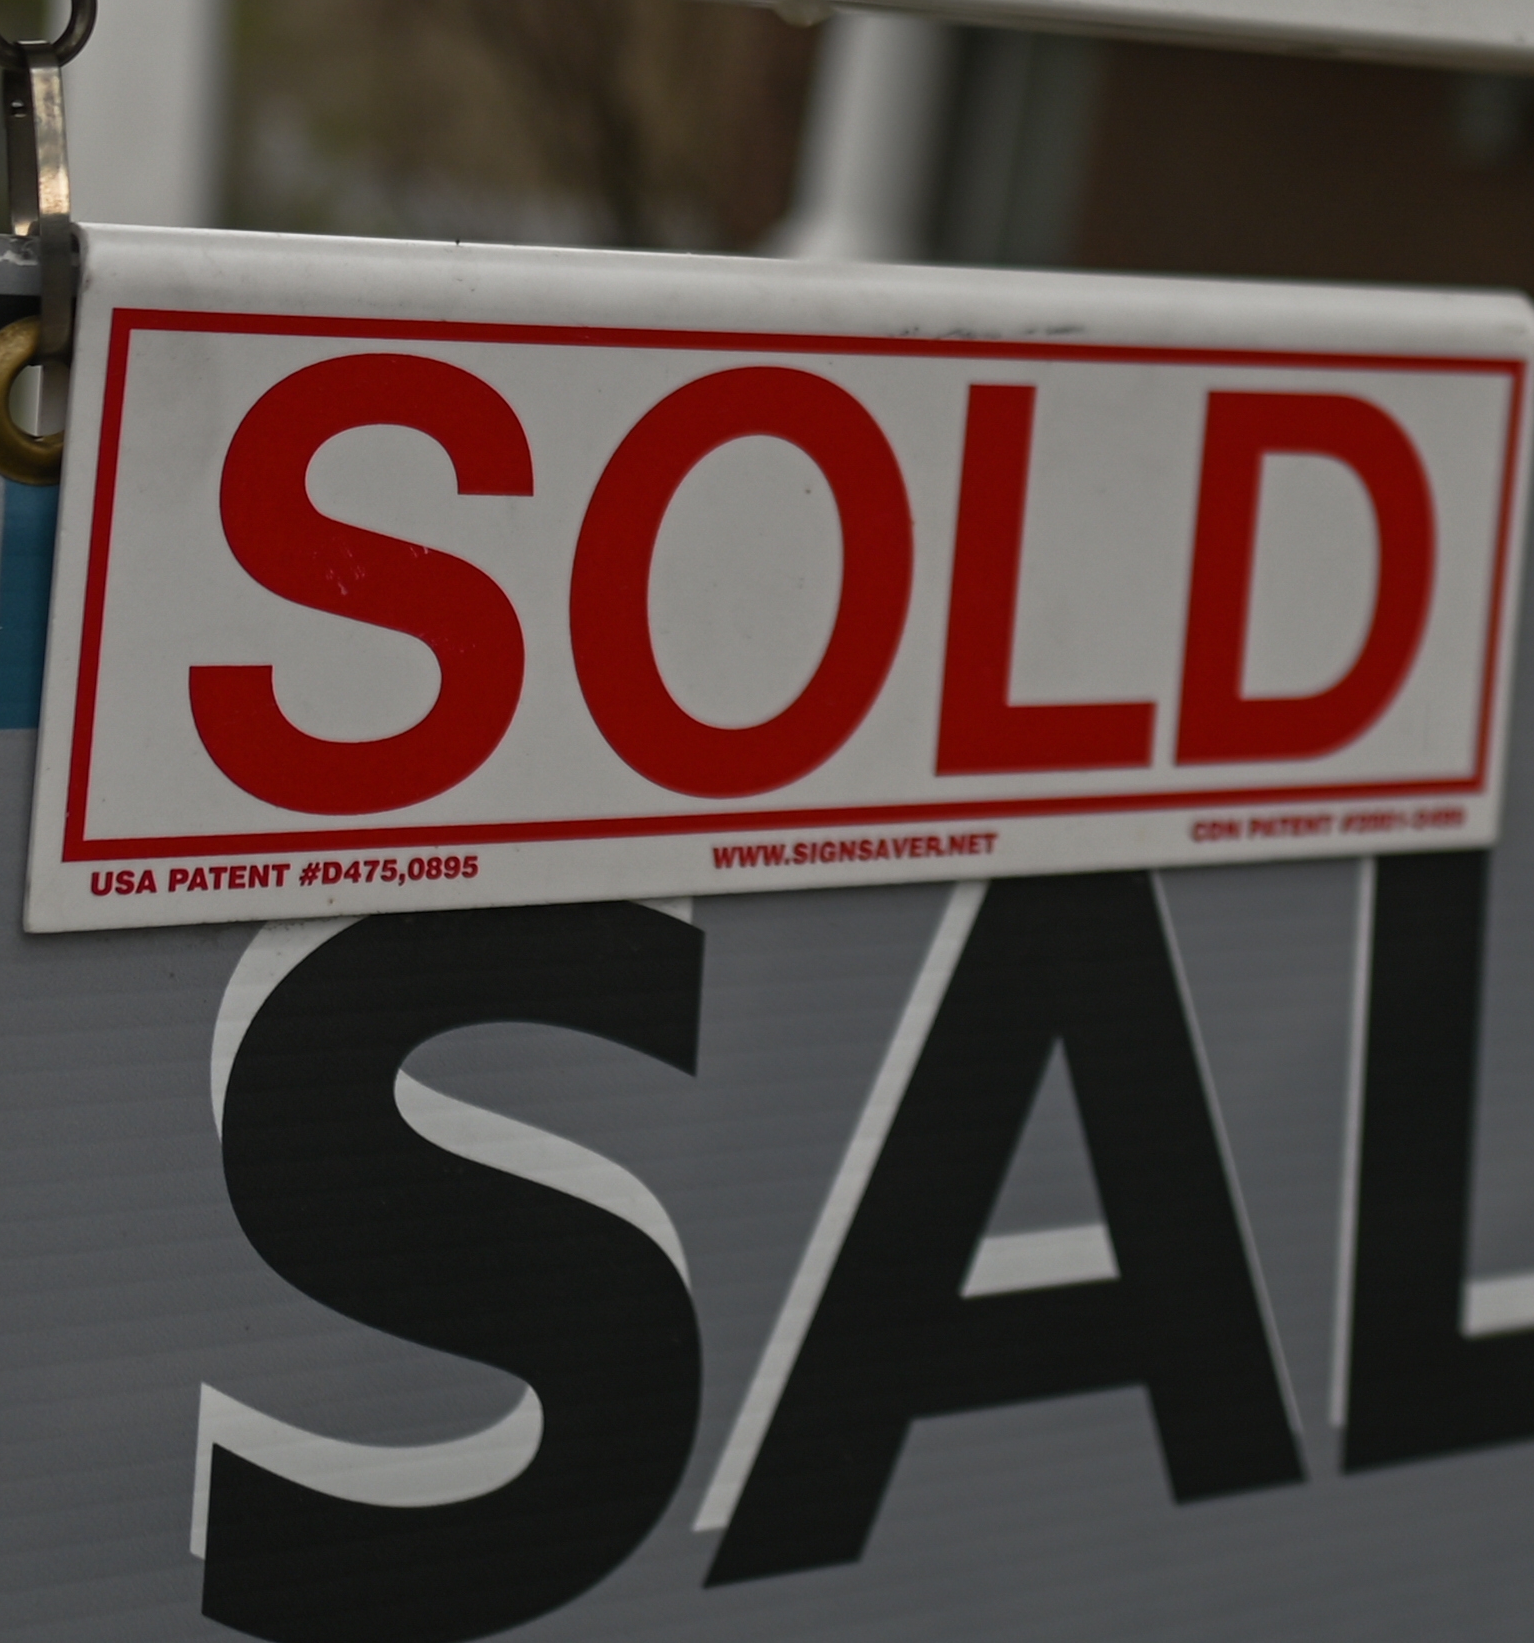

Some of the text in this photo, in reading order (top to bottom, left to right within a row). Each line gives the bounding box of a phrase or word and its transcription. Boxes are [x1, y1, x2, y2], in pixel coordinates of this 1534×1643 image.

[187, 353, 1437, 816] SOLD
[1191, 819, 1241, 843] CDN
[1248, 813, 1333, 838] PATENT
[712, 832, 998, 869] WWW.SIGNSAVER.NET
[90, 855, 479, 896] USA PATENT #D475,0895
